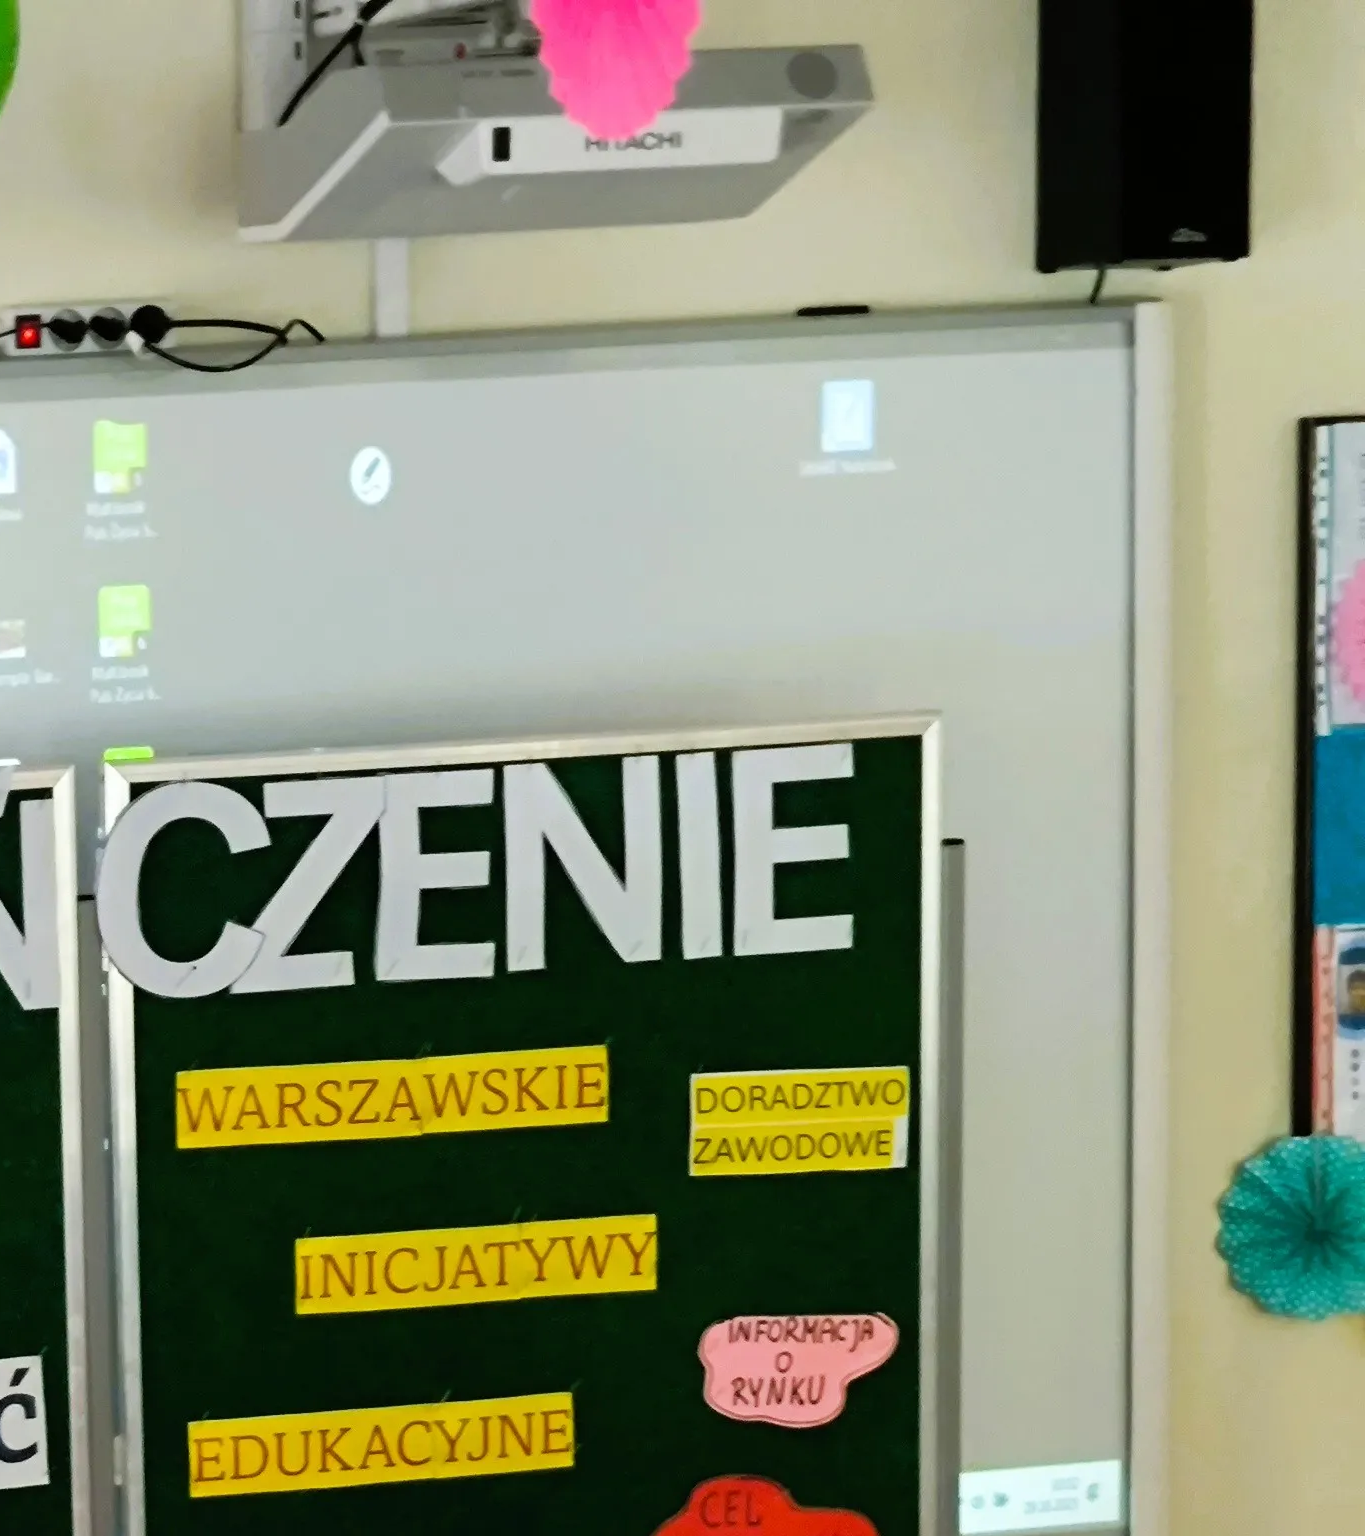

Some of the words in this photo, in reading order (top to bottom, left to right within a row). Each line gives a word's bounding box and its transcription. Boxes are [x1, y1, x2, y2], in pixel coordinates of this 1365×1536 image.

[178, 1061, 606, 1133] WARSZAWSKIE
[695, 1077, 905, 1114] DORADZTWO
[693, 1130, 892, 1164] ZAWODOWE
[301, 1230, 656, 1300] INICJATYWY
[728, 1316, 874, 1352] INFORMACJA
[775, 1351, 794, 1374] O
[730, 1375, 826, 1408] RYNKU
[192, 1408, 572, 1484] EDUKACYJNE
[699, 1489, 763, 1530] CEL
